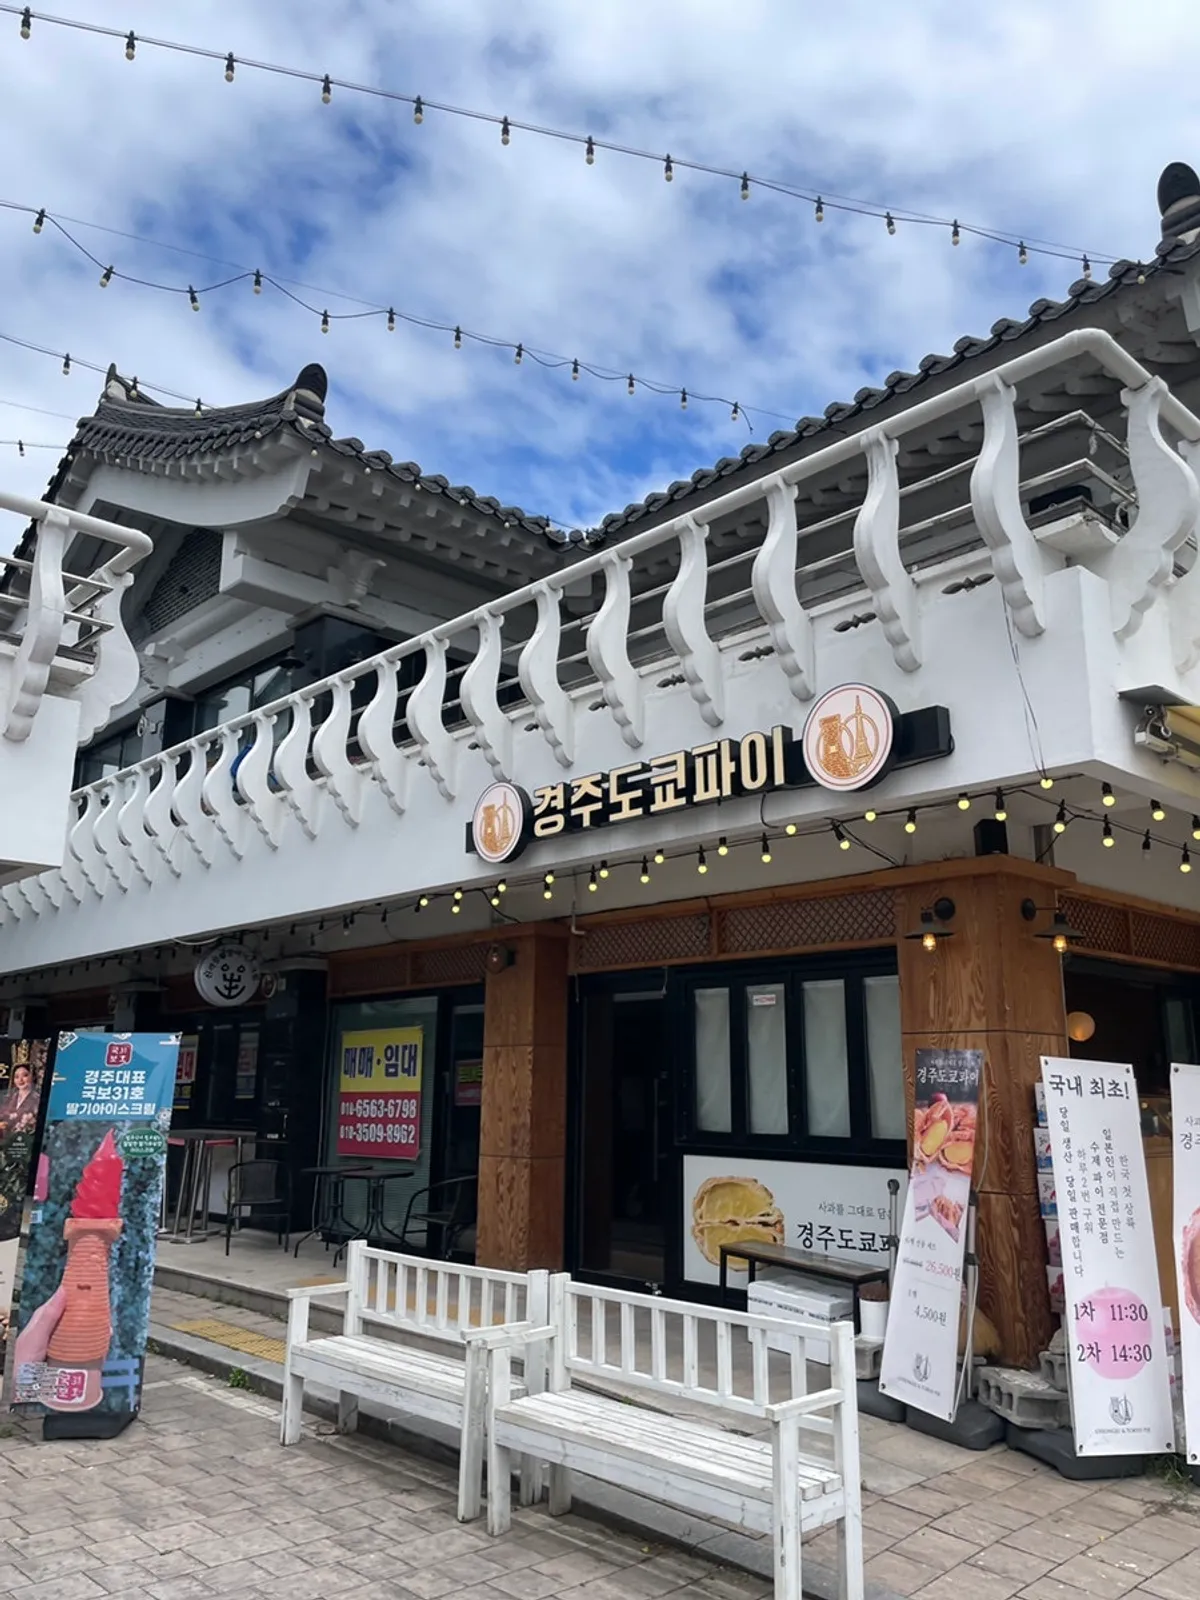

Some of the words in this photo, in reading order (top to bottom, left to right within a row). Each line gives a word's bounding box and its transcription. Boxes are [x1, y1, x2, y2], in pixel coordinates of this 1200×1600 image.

[533, 726, 784, 838] 경주도쿄파이
[85, 1070, 146, 1085] 경주대표
[1049, 1074, 1083, 1098] 국내
[1089, 1077, 1130, 1100] 최초!
[81, 1086, 144, 1100] 국보31호
[66, 1103, 156, 1116] 딸기아이스크림
[340, 1099, 417, 1118] 010-6563-6798
[340, 1123, 415, 1143] 010-3509-8962
[1090, 1141, 1101, 1166] 수제
[1102, 1128, 1116, 1181] 일본인이
[1119, 1154, 1130, 1181] 한국
[1059, 1106, 1069, 1133] 당일
[1069, 1206, 1084, 1277] 판매합니다
[1093, 1171, 1104, 1198] 파이
[819, 1201, 844, 1216] 사과를
[847, 1205, 875, 1217] 그대로
[1109, 1186, 1120, 1213] 직접
[1096, 1203, 1109, 1245] 전문점
[1111, 1217, 1125, 1259] 만드는
[914, 1305, 947, 1327] 4,500원
[1074, 1301, 1096, 1322] 1차
[1110, 1304, 1148, 1321] 11:30
[1077, 1341, 1102, 1363] 2차
[1111, 1344, 1152, 1362] 14:30
